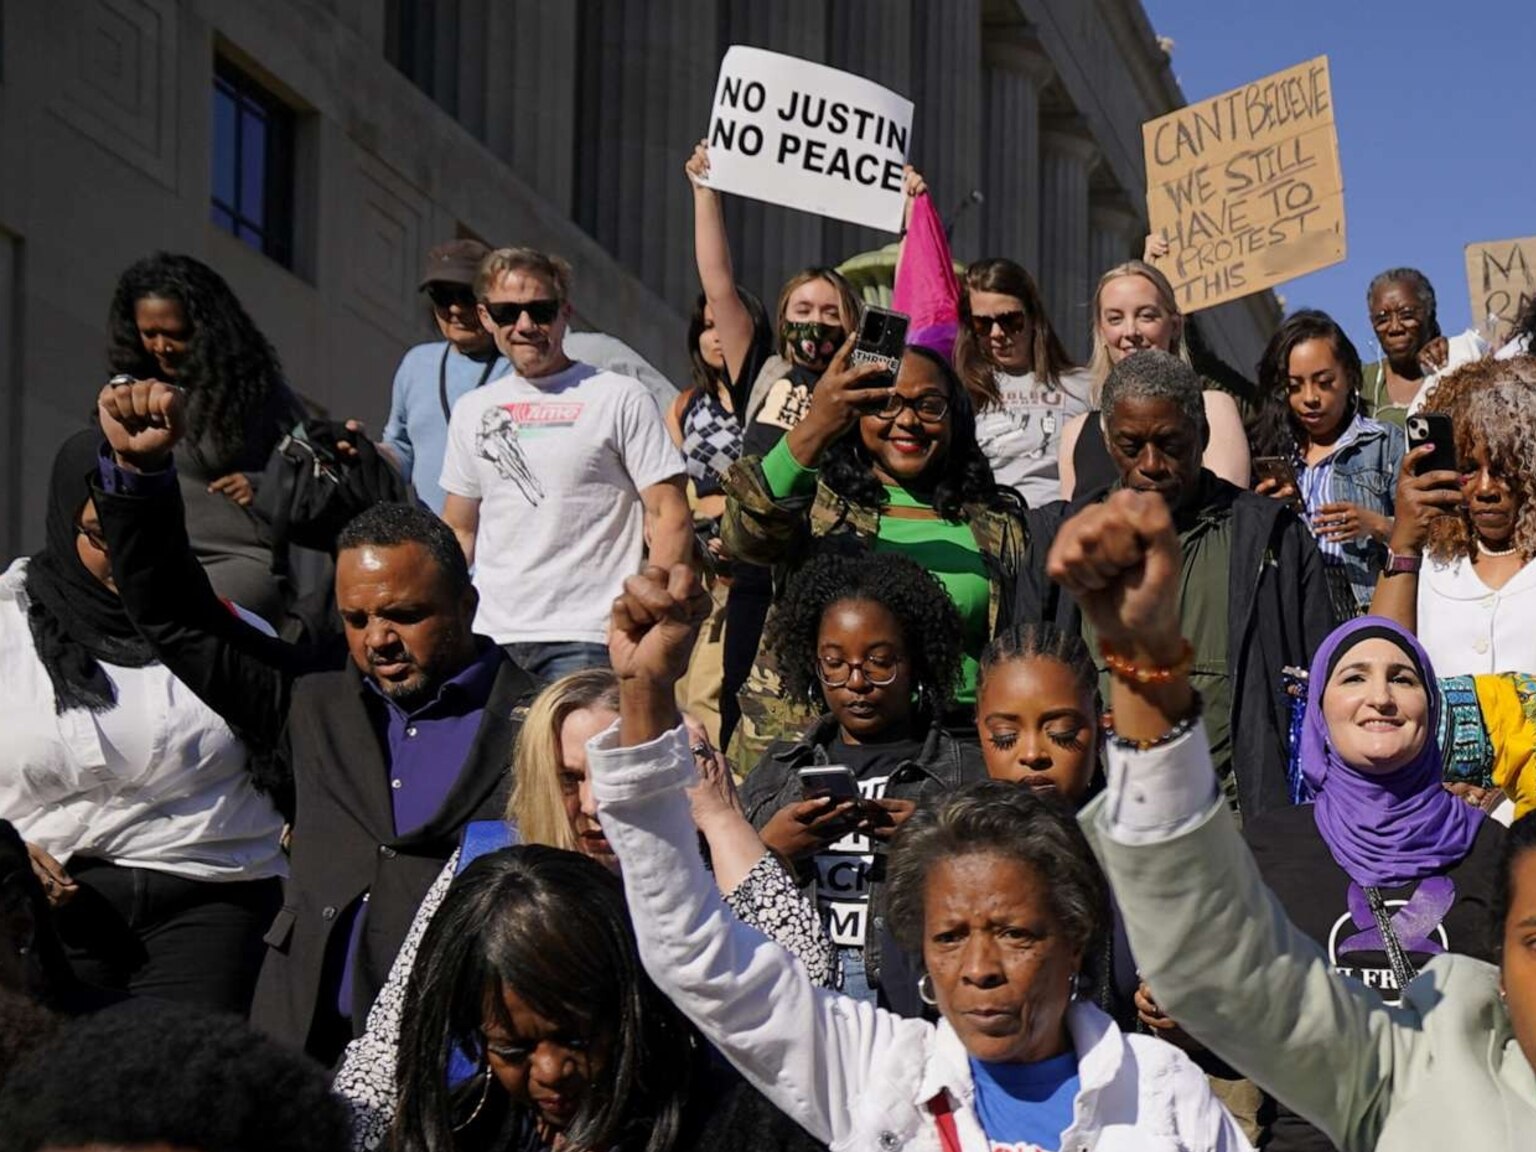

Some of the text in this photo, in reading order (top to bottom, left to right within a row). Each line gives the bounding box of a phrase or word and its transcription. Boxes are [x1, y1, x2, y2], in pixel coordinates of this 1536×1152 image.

[720, 76, 907, 155] NO JUSTIN
[1245, 66, 1330, 140] BELIEVE
[711, 117, 905, 192] NO PEACE
[1162, 138, 1316, 214] WE STILL
[1162, 198, 1250, 249] HAVE
[1258, 177, 1313, 218] TO
[1176, 205, 1321, 278] PROTEST
[1173, 262, 1247, 302] THIS
